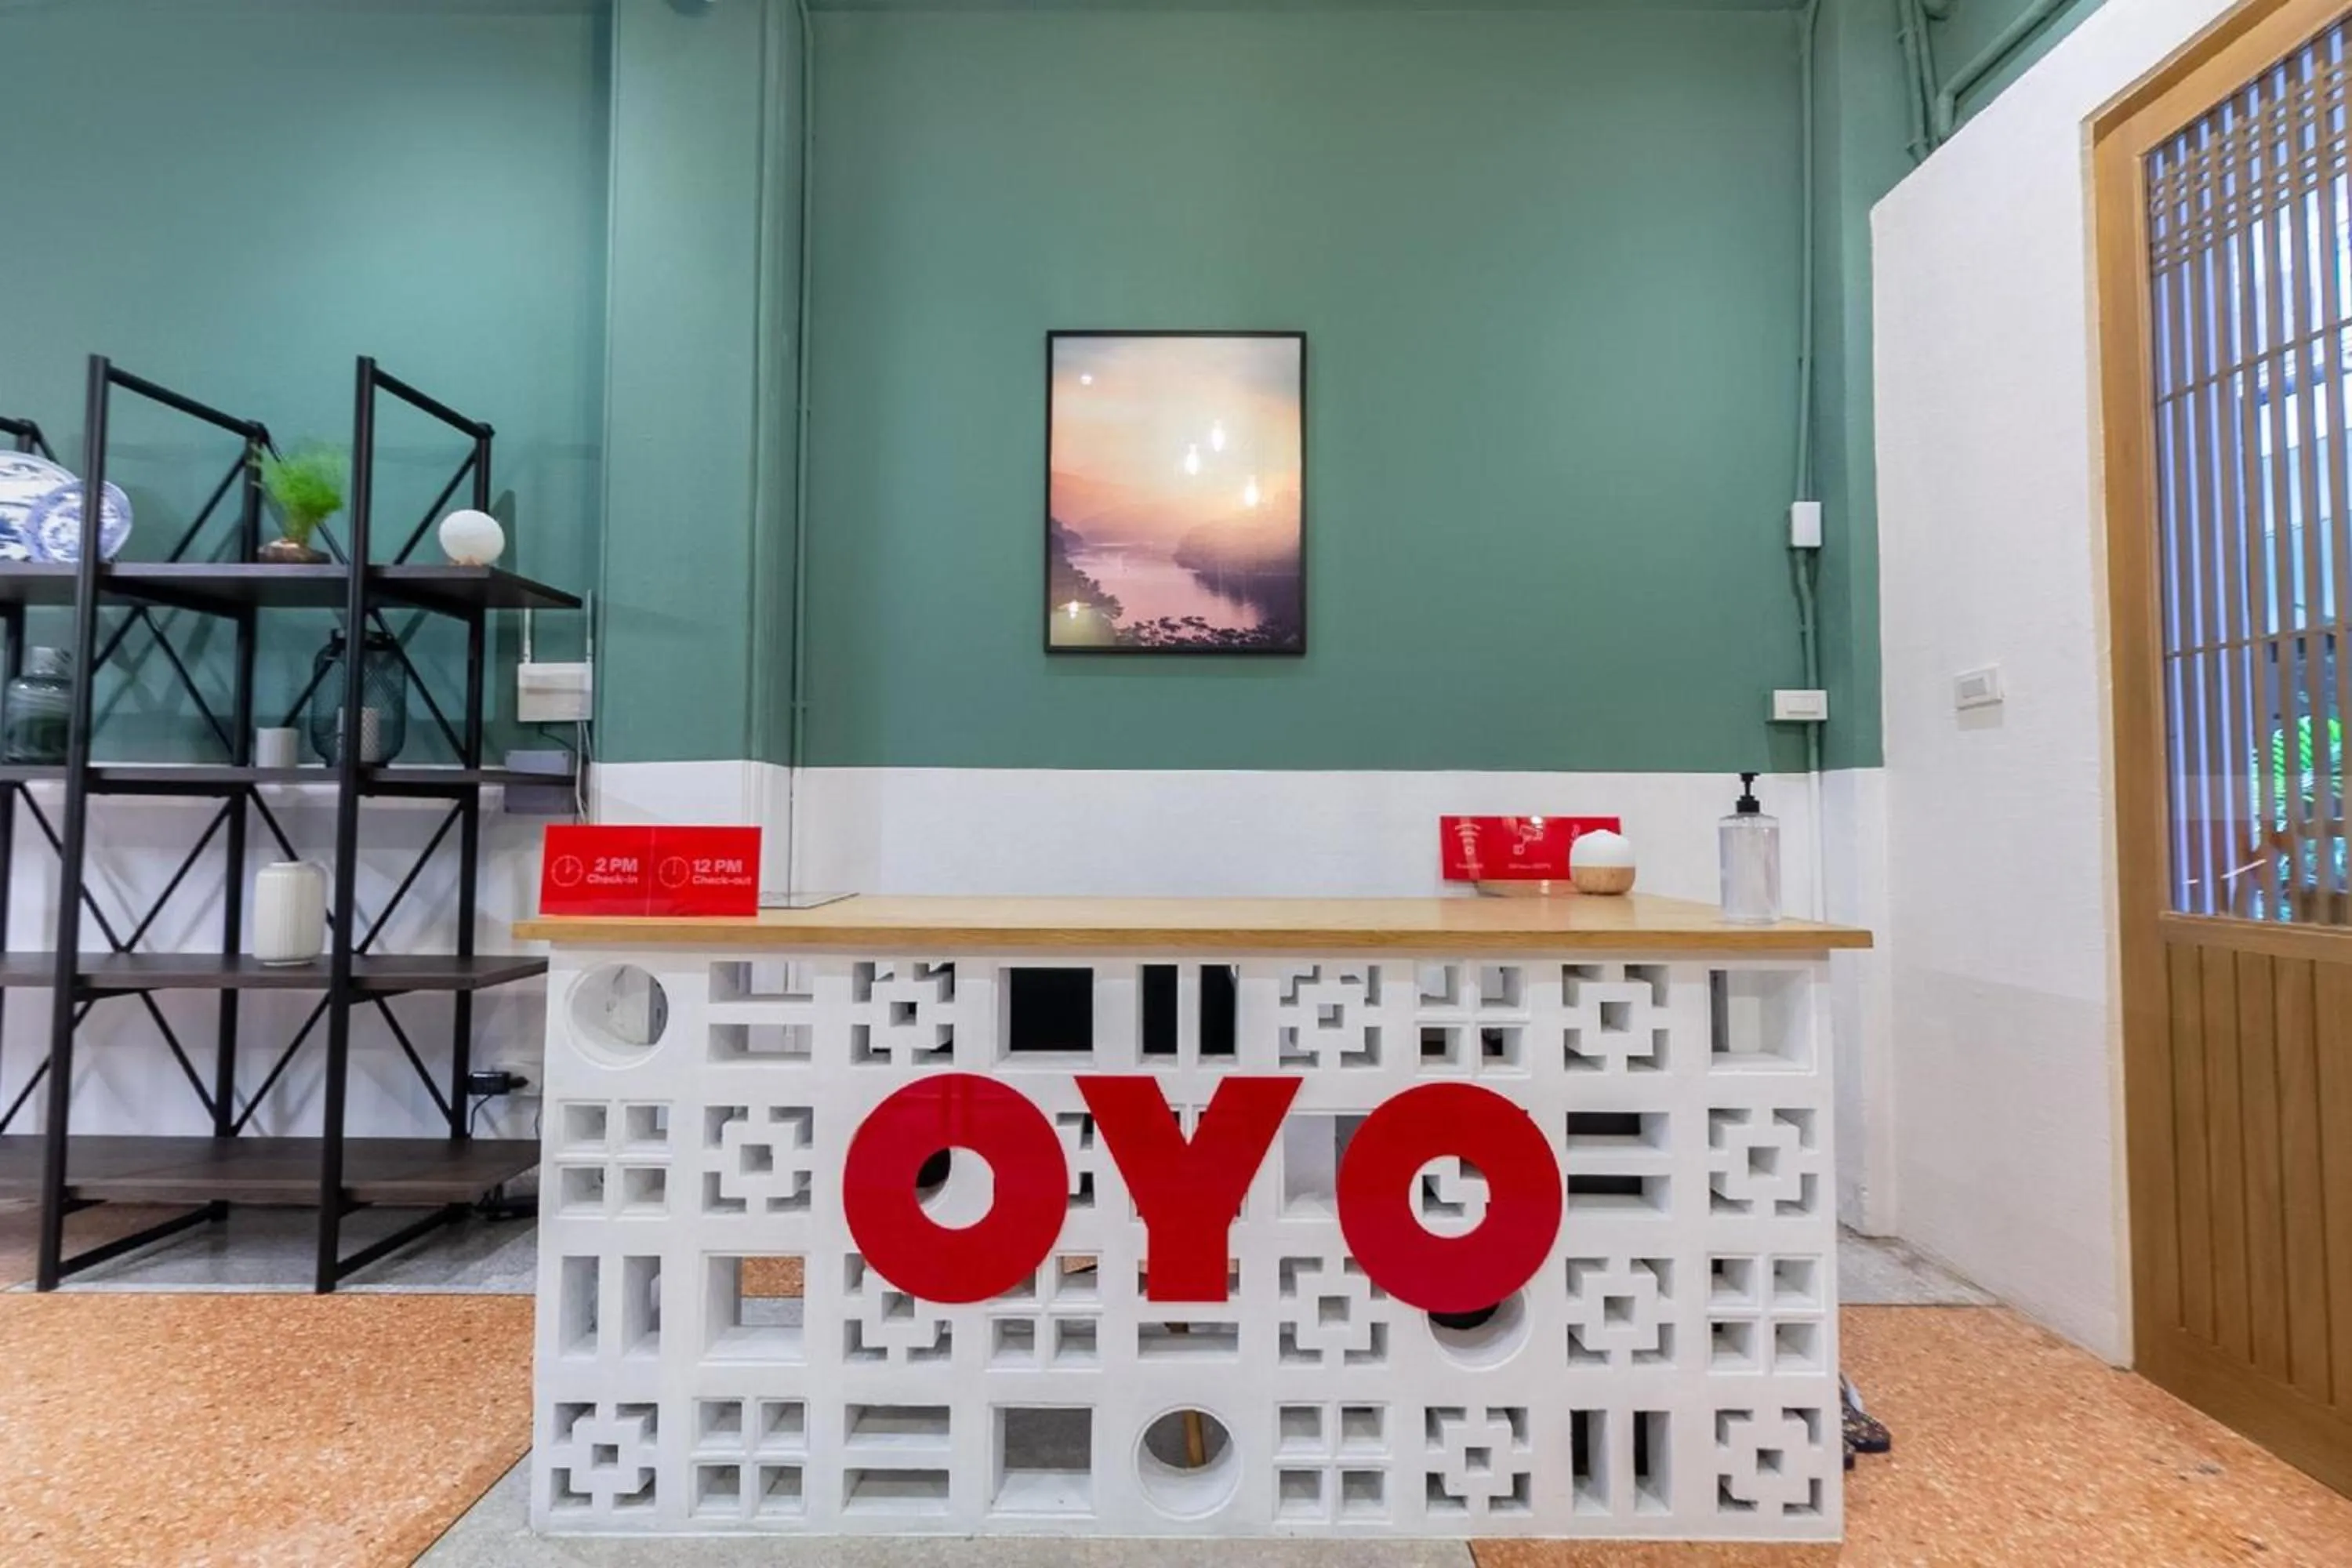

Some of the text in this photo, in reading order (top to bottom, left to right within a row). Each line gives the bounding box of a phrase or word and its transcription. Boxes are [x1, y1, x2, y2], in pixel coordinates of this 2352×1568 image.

[594, 857, 638, 873] 2 PM
[692, 858, 742, 873] 12 PM
[586, 873, 638, 884] Check-in
[692, 875, 752, 885] Check-out
[843, 1073, 1563, 1313] OYO
